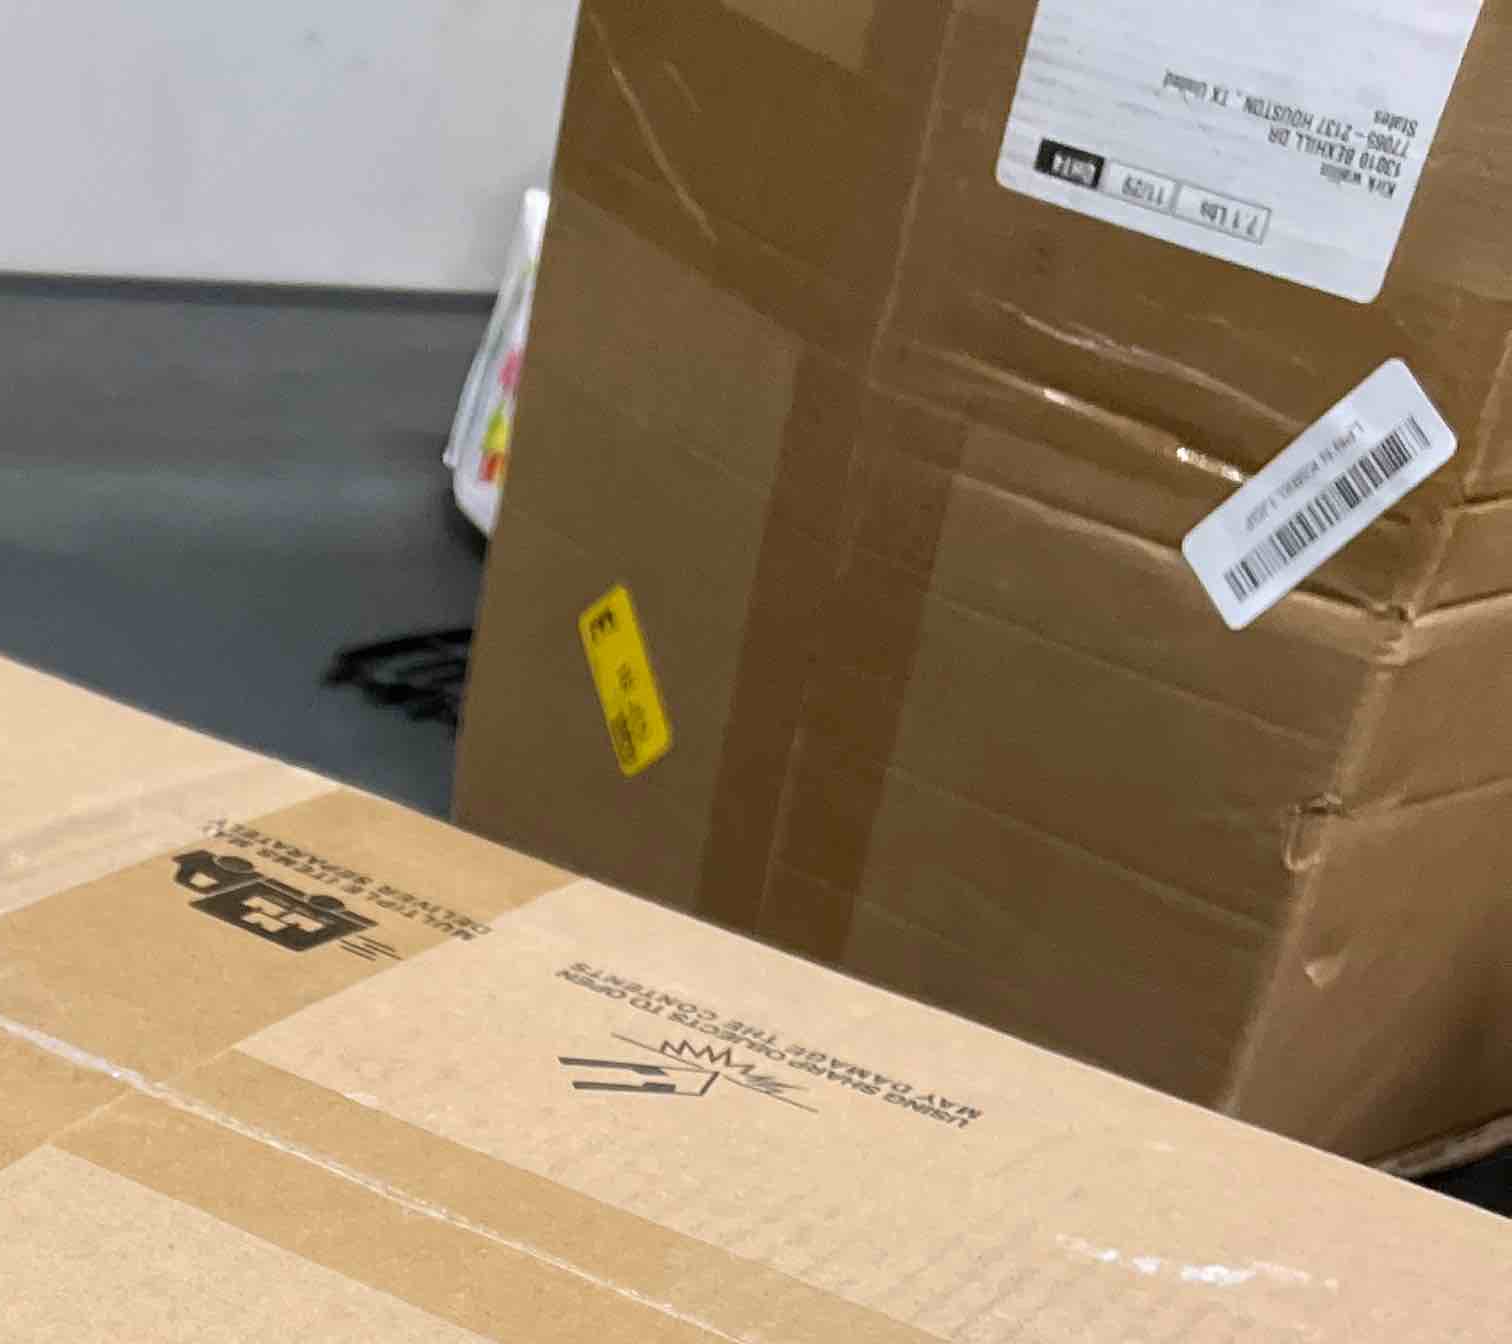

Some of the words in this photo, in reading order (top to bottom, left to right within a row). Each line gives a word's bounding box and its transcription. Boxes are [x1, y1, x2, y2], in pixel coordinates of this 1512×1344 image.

[568, 961, 718, 1021] CONTENTS
[628, 997, 664, 1016] TO
[667, 1010, 786, 1062] OBJECTS
[723, 1019, 778, 1045] THE
[785, 1045, 912, 1095] DAMAGE
[787, 1059, 882, 1095] SHARP
[883, 1092, 969, 1128] USING
[912, 1093, 983, 1120] MAY
